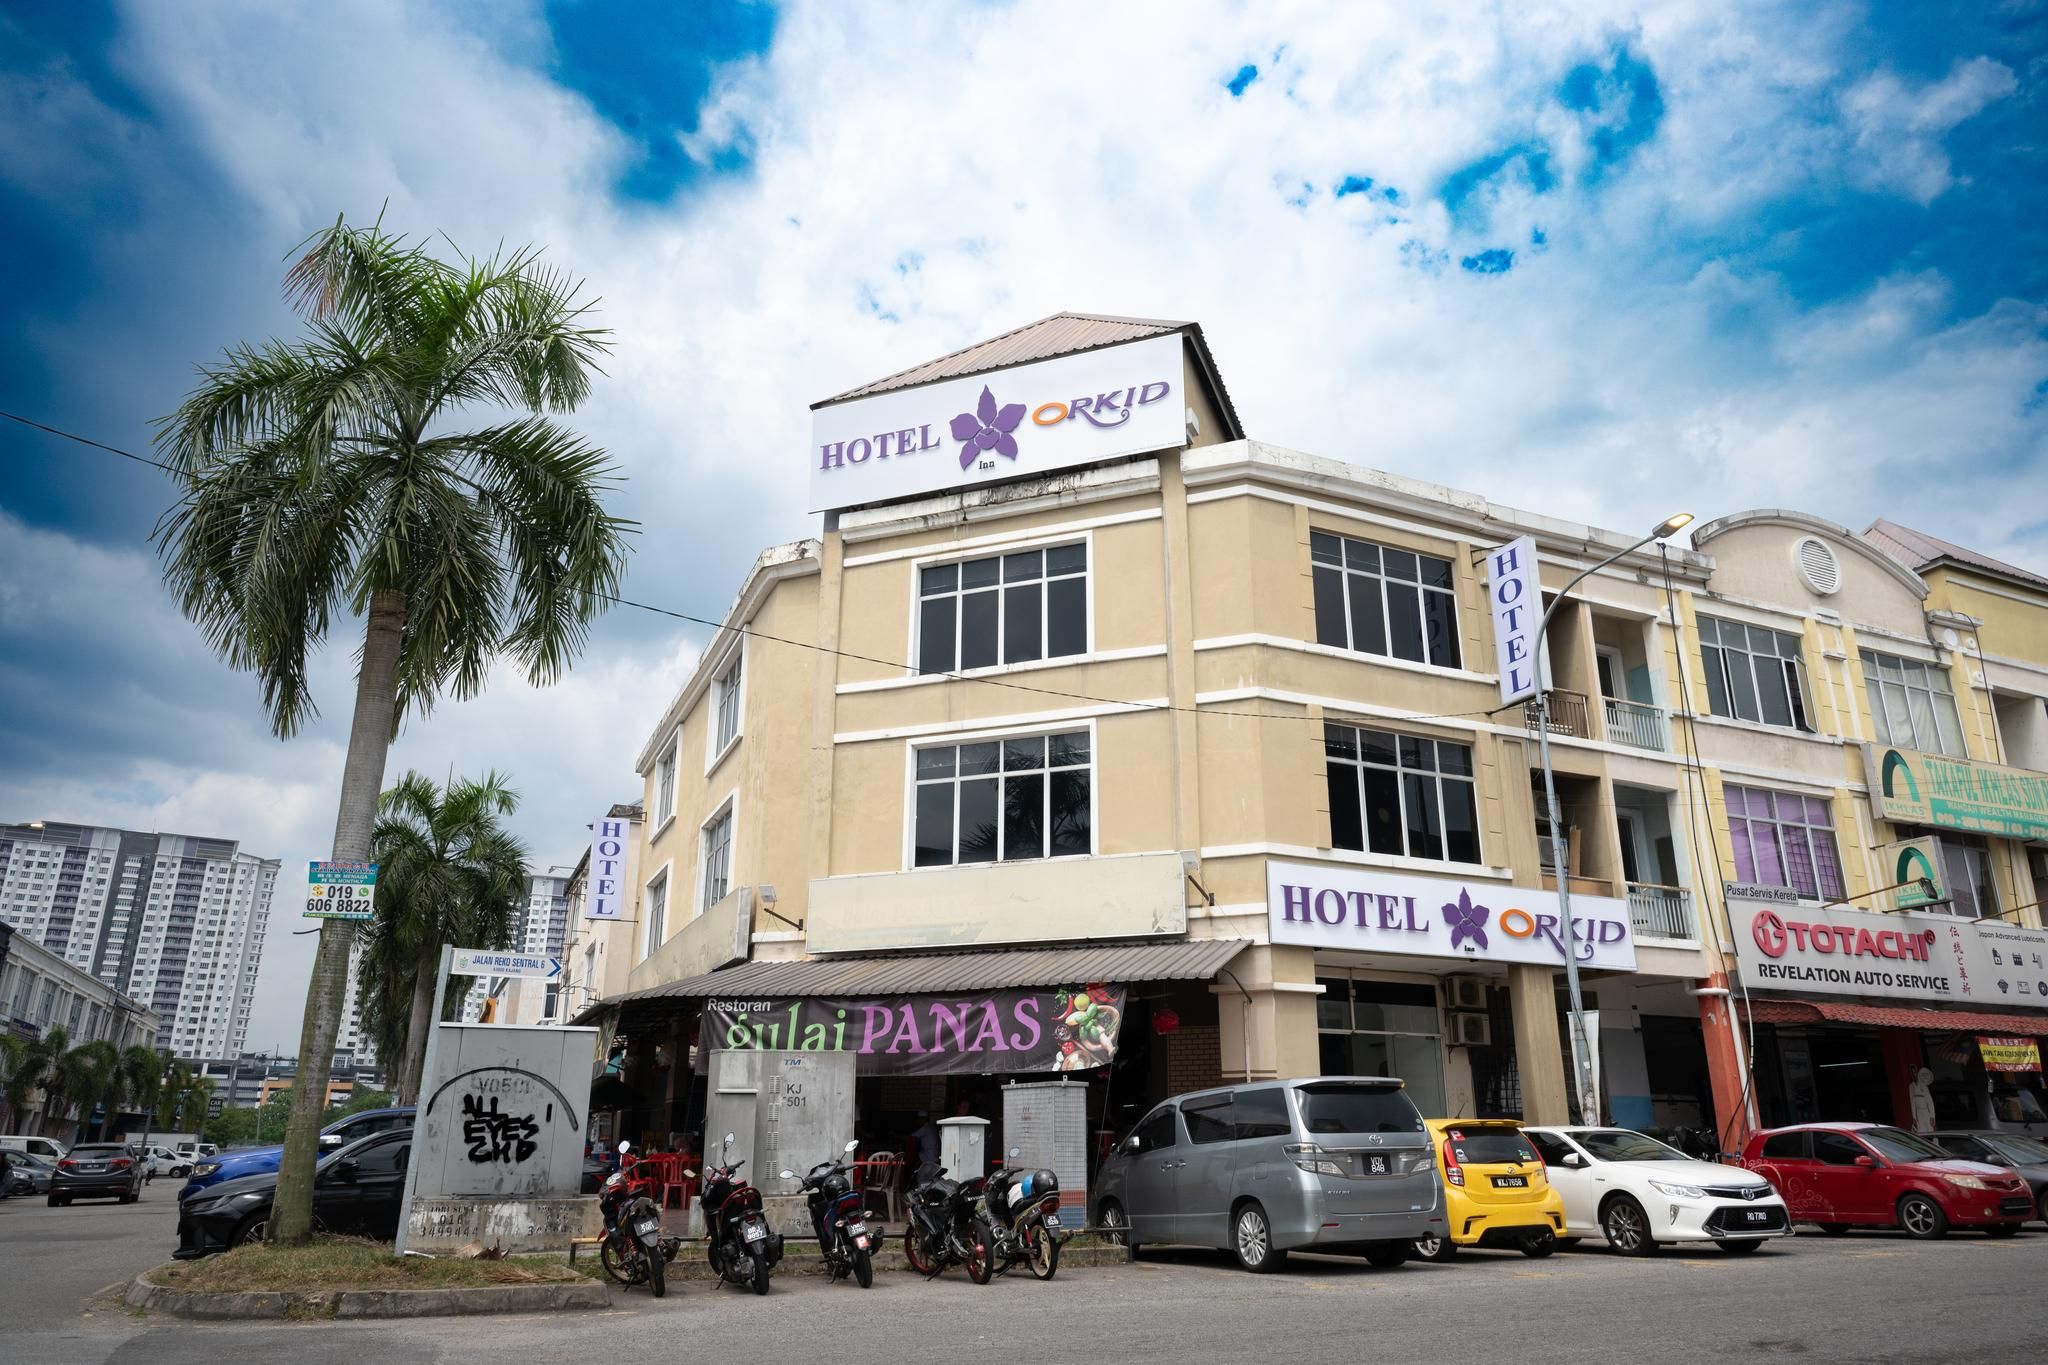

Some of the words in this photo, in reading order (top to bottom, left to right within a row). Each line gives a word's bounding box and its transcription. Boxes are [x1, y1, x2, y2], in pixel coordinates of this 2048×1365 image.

[820, 424, 941, 470] HOTEL
[1032, 381, 1170, 428] ORKID
[979, 460, 995, 470] Inn
[1495, 546, 1531, 694] HOTEL
[1925, 760, 1979, 801] TAKAFUL
[1977, 768, 2021, 808] IKHLAS
[1885, 802, 1926, 816] IKHLAS
[595, 822, 621, 915] HOTEL
[328, 885, 353, 898] 019
[1726, 884, 1748, 897] Pusat
[1749, 886, 1773, 899] Servis
[1773, 888, 1797, 901] Kereta
[306, 898, 332, 912] 606
[336, 899, 370, 913] 8822
[1280, 884, 1430, 932] HOTEL
[1786, 921, 1930, 961] TOTACHI
[1978, 930, 1994, 938] Japan
[1995, 931, 2021, 941] Advanced
[2021, 934, 2046, 943] Lubricants
[472, 955, 494, 965] JALAN
[494, 956, 511, 967] REKO
[512, 958, 539, 968] SENTRAL
[1758, 963, 1850, 984] REVELATION
[1854, 970, 1893, 987] AUTO
[1896, 974, 1950, 991] SERVICE
[707, 998, 771, 1012] Restoran
[725, 1002, 847, 1050] gulai
[857, 997, 1041, 1054] PANAS
[786, 1083, 802, 1095] KJ
[464, 1114, 539, 1143] EYES
